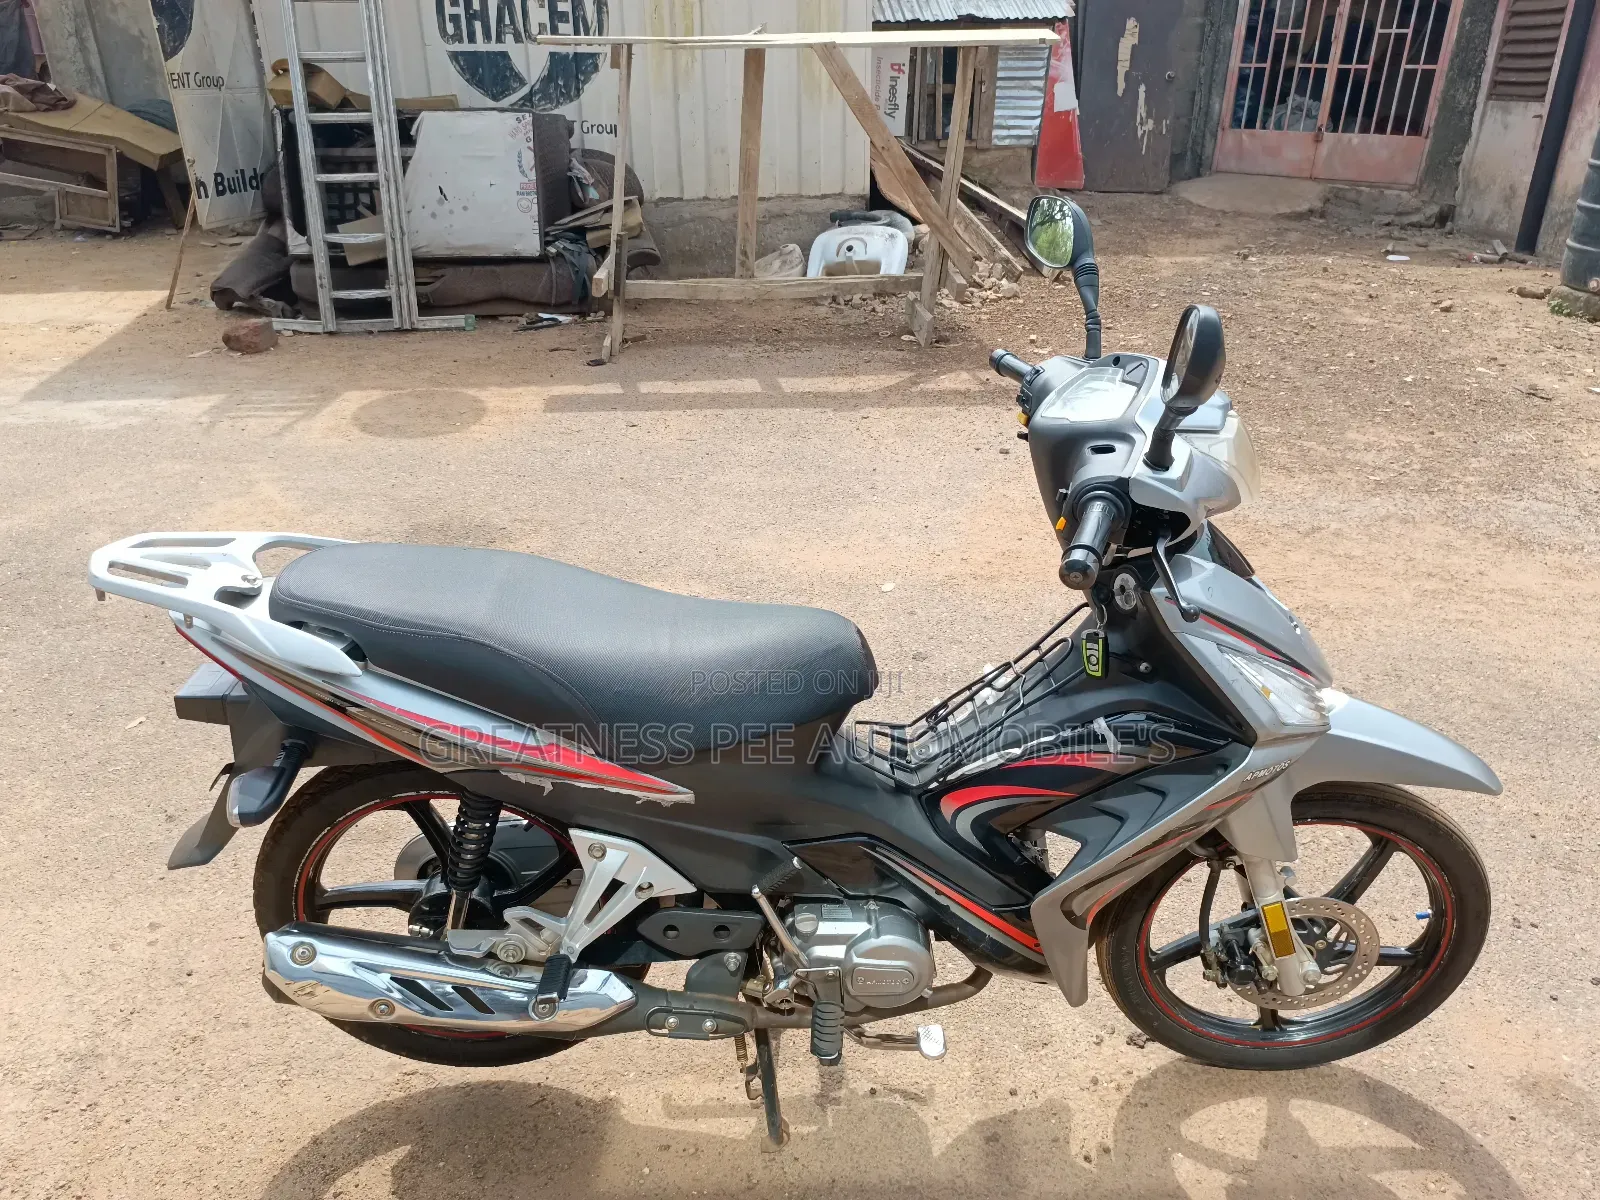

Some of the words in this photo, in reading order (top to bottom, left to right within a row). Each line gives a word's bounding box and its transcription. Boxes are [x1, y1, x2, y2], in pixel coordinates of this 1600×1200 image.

[435, 0, 610, 46] GHACEM
[194, 71, 225, 91] Group
[874, 56, 884, 102] Insecticide
[884, 76, 901, 120] Inesfly
